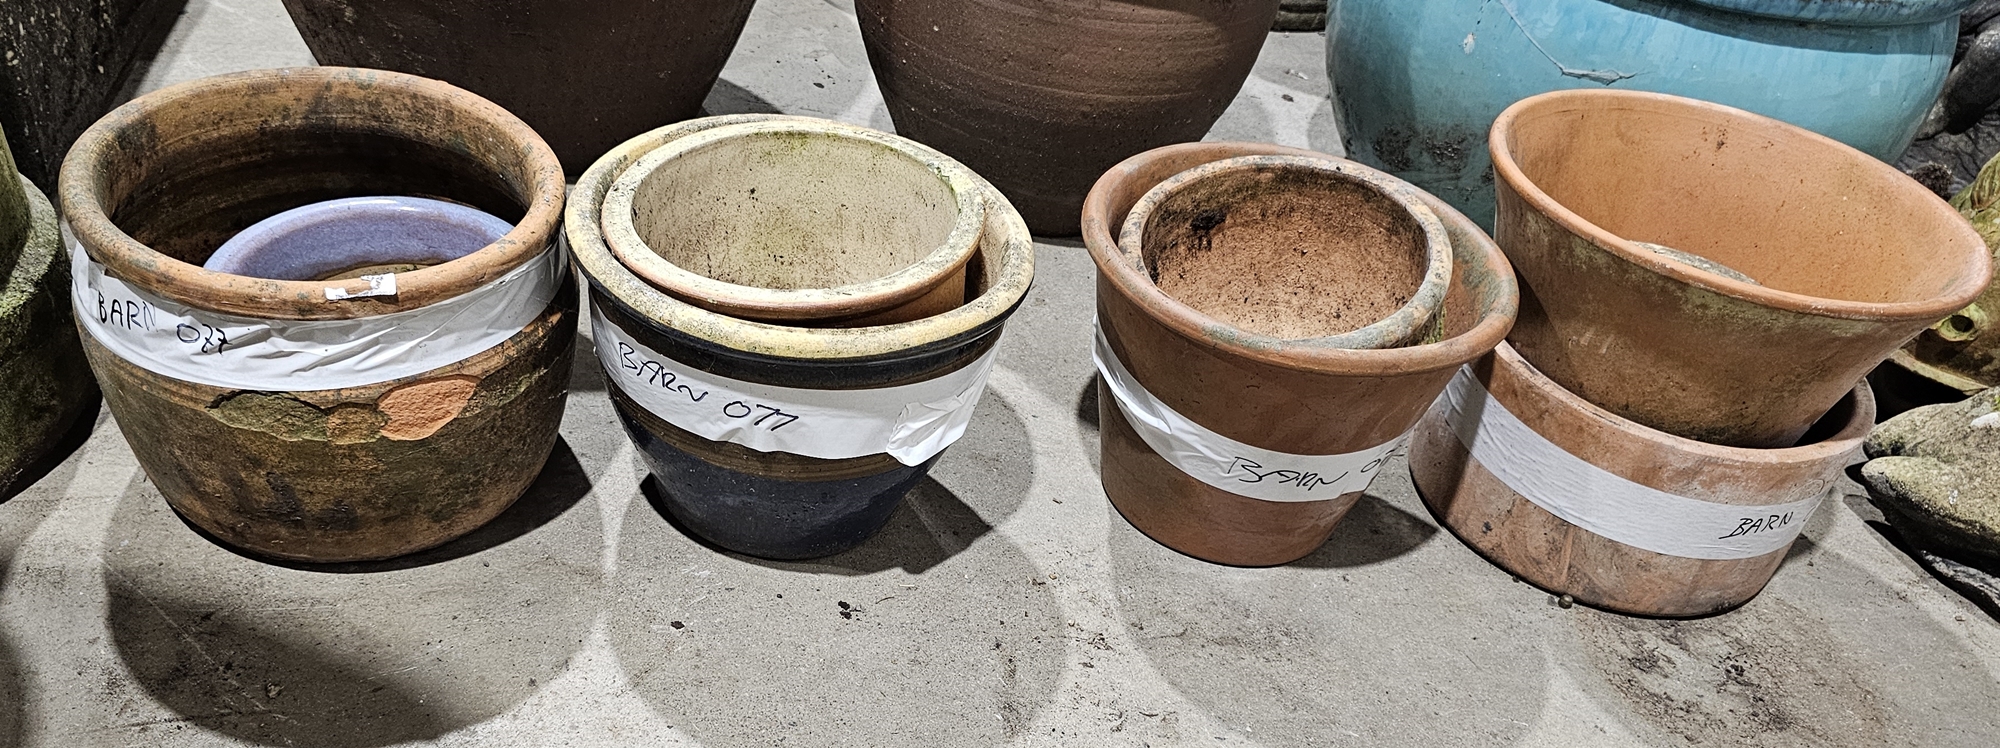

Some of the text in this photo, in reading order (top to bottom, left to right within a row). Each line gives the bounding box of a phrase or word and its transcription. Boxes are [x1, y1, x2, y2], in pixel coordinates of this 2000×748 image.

[98, 291, 232, 355] BARN 077
[618, 341, 799, 432] BARN 077
[1718, 511, 1794, 539] BARN
